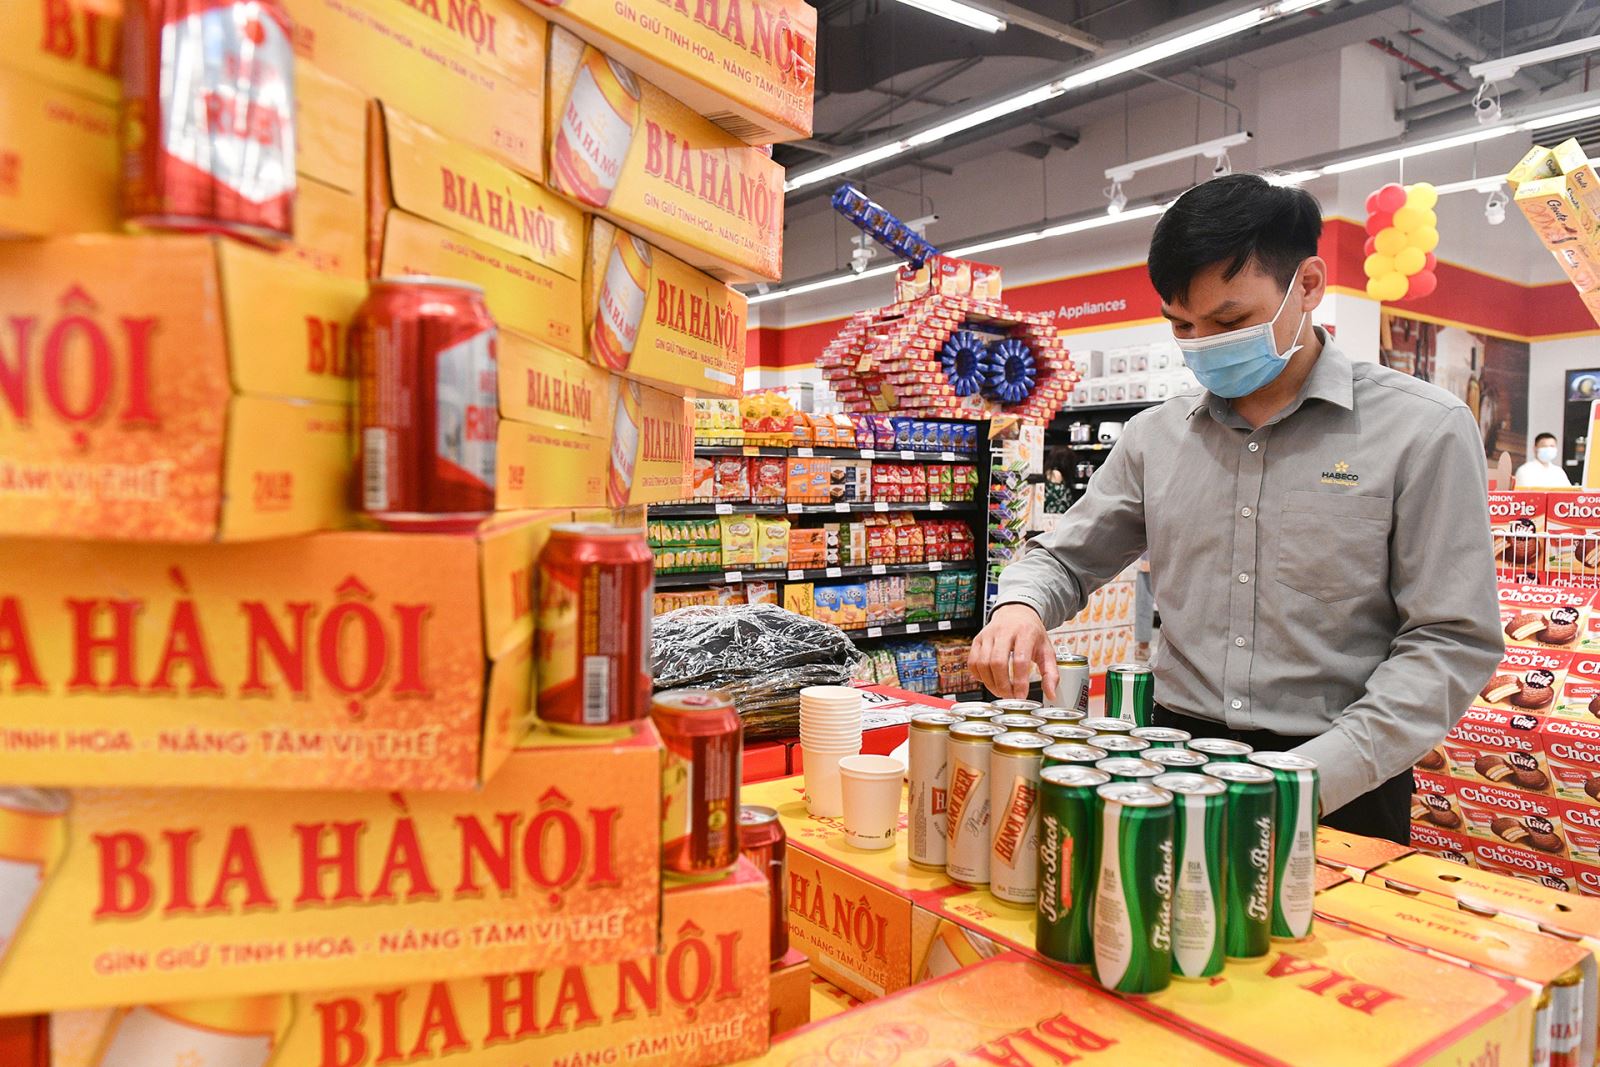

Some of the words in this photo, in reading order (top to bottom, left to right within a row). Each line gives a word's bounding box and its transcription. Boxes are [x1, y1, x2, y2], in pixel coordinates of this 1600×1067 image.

[663, 26, 690, 50] TINH
[692, 42, 715, 65] HOA
[643, 117, 696, 197] BIA
[698, 145, 737, 217] HÀ
[739, 171, 777, 240] NỘI
[441, 166, 484, 225] BIA
[485, 185, 520, 241] HÀ
[521, 205, 558, 258] NỘI
[655, 278, 687, 335] BIA
[689, 287, 713, 345] HÀ
[713, 301, 740, 361] NỘI
[1058, 299, 1127, 320] Appliances
[527, 367, 550, 409] BIA
[552, 370, 571, 418] HÀ
[643, 415, 662, 462] BIA
[663, 405, 681, 463] HÀ
[1321, 471, 1359, 482] HABECO
[67, 565, 224, 696] HÀ
[239, 574, 432, 722] NỘI
[1474, 725, 1505, 736] ORION
[953, 767, 978, 802] BEER
[1460, 786, 1550, 817] ChocoPie
[1489, 787, 1522, 800] ORION
[994, 813, 1023, 863] HANOI
[1014, 784, 1038, 825] BEER
[92, 825, 278, 926] BIA
[293, 790, 441, 912] HÀ
[453, 784, 624, 910] NỘI
[1476, 845, 1565, 878] ChocoPie
[1507, 847, 1538, 860] ORION
[788, 869, 831, 933] HÀ
[832, 894, 888, 965] NỘI
[292, 935, 356, 960] HOA
[314, 979, 473, 1067] BIA
[611, 918, 742, 1022] NỘI
[1264, 952, 1405, 1016] BIA
